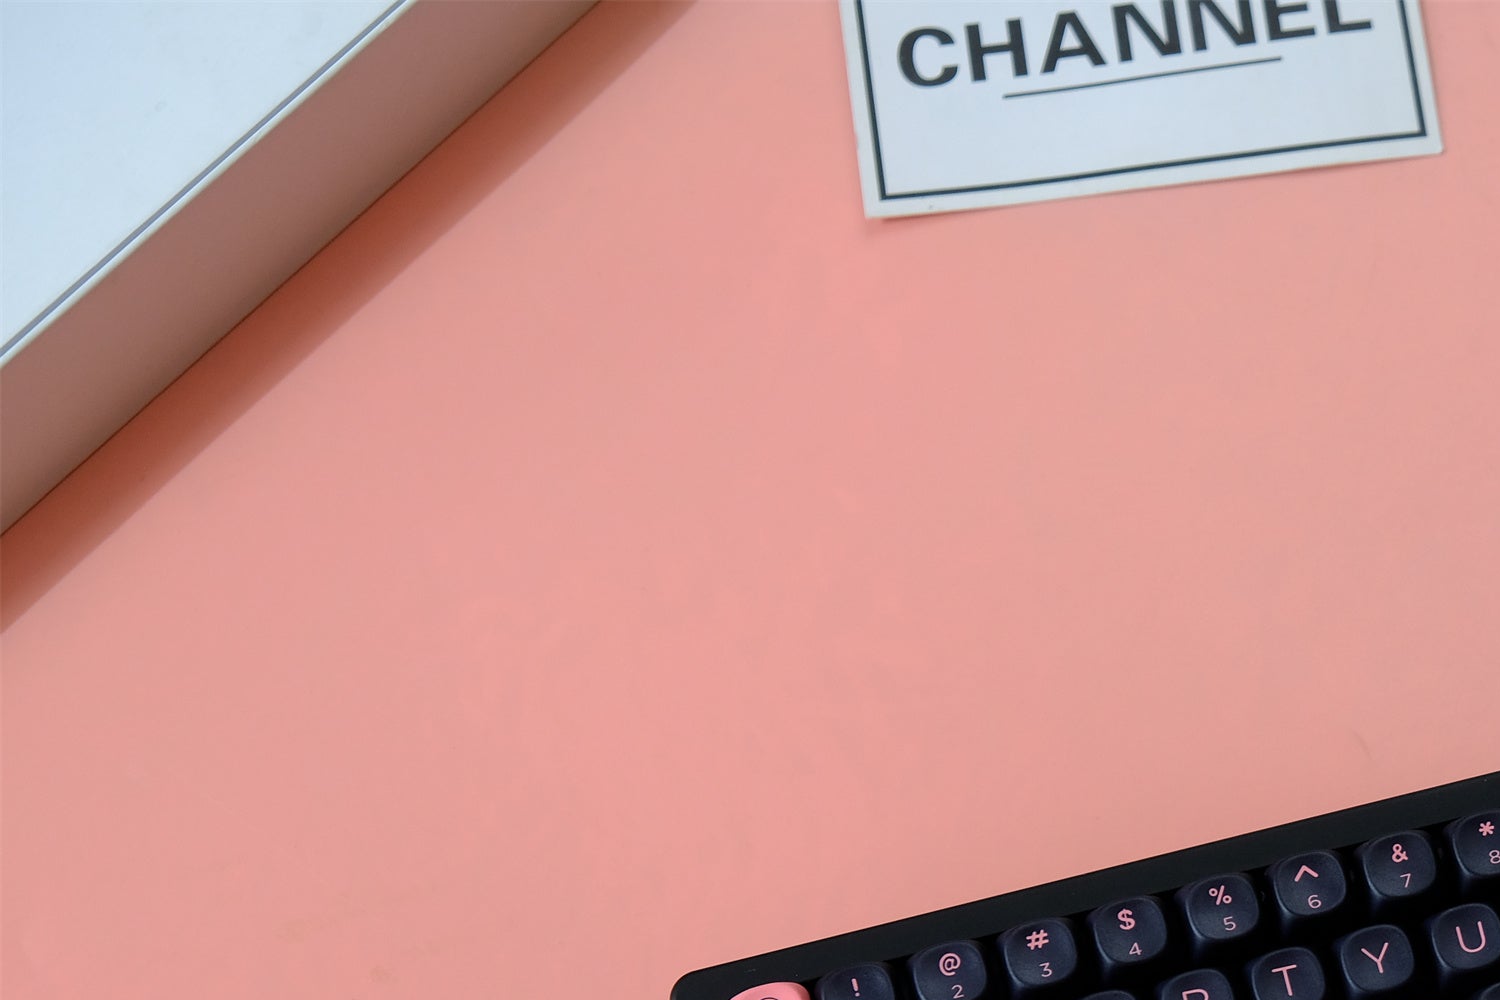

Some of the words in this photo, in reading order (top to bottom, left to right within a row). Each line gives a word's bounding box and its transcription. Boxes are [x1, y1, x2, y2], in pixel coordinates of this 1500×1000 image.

[897, 0, 1373, 87] CHANNEL
[1391, 843, 1409, 863] &
[1294, 865, 1319, 882] ^
[1399, 873, 1411, 888] 7
[1208, 885, 1232, 906] %
[1307, 894, 1322, 909] 6
[1117, 908, 1136, 930] $
[1223, 916, 1237, 931] 5
[1026, 929, 1049, 950] #
[1455, 920, 1486, 953] U
[1129, 942, 1142, 956] 4
[1361, 942, 1389, 974] Y
[939, 952, 961, 976] @
[1039, 962, 1053, 978] 3
[1271, 964, 1297, 997] T
[951, 984, 964, 999] 2
